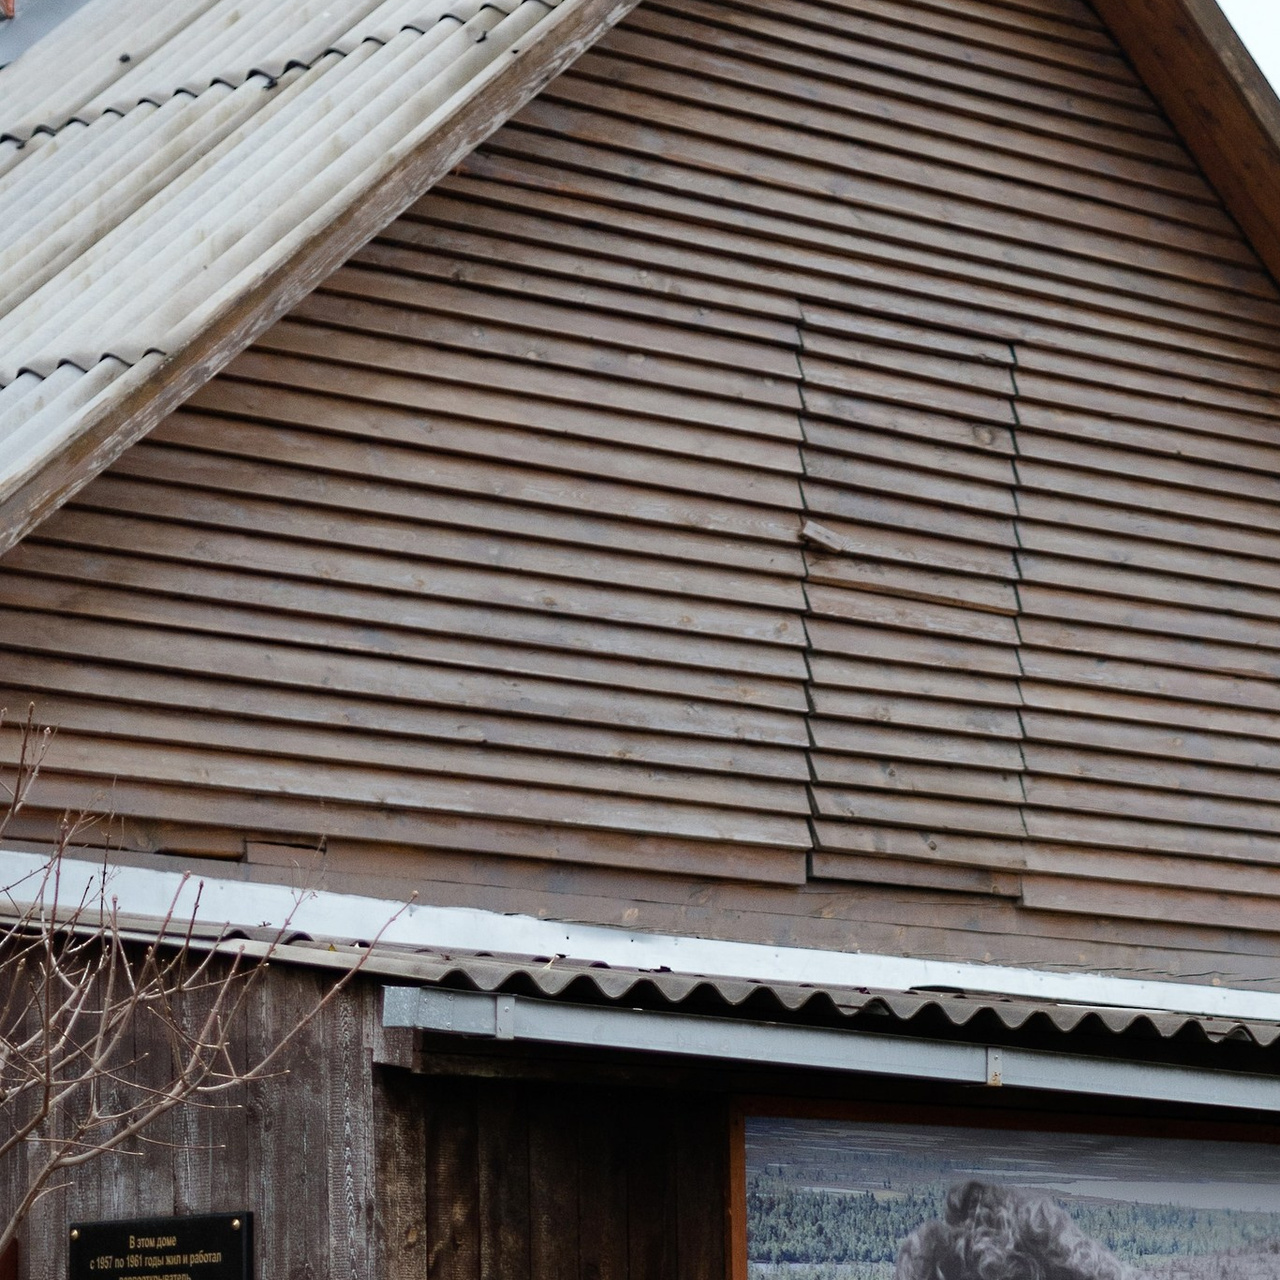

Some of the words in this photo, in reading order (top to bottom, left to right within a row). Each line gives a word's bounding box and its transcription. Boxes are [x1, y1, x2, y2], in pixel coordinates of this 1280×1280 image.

[129, 1235, 135, 1249] В
[137, 1237, 155, 1248] этом
[157, 1236, 176, 1249] доме
[90, 1260, 94, 1269] с
[97, 1256, 112, 1269] 1957
[115, 1258, 124, 1268] по
[127, 1254, 142, 1267] 1961
[145, 1255, 164, 1267] годы
[166, 1254, 181, 1265] жил
[183, 1254, 187, 1264] и
[190, 1251, 221, 1266] работал
